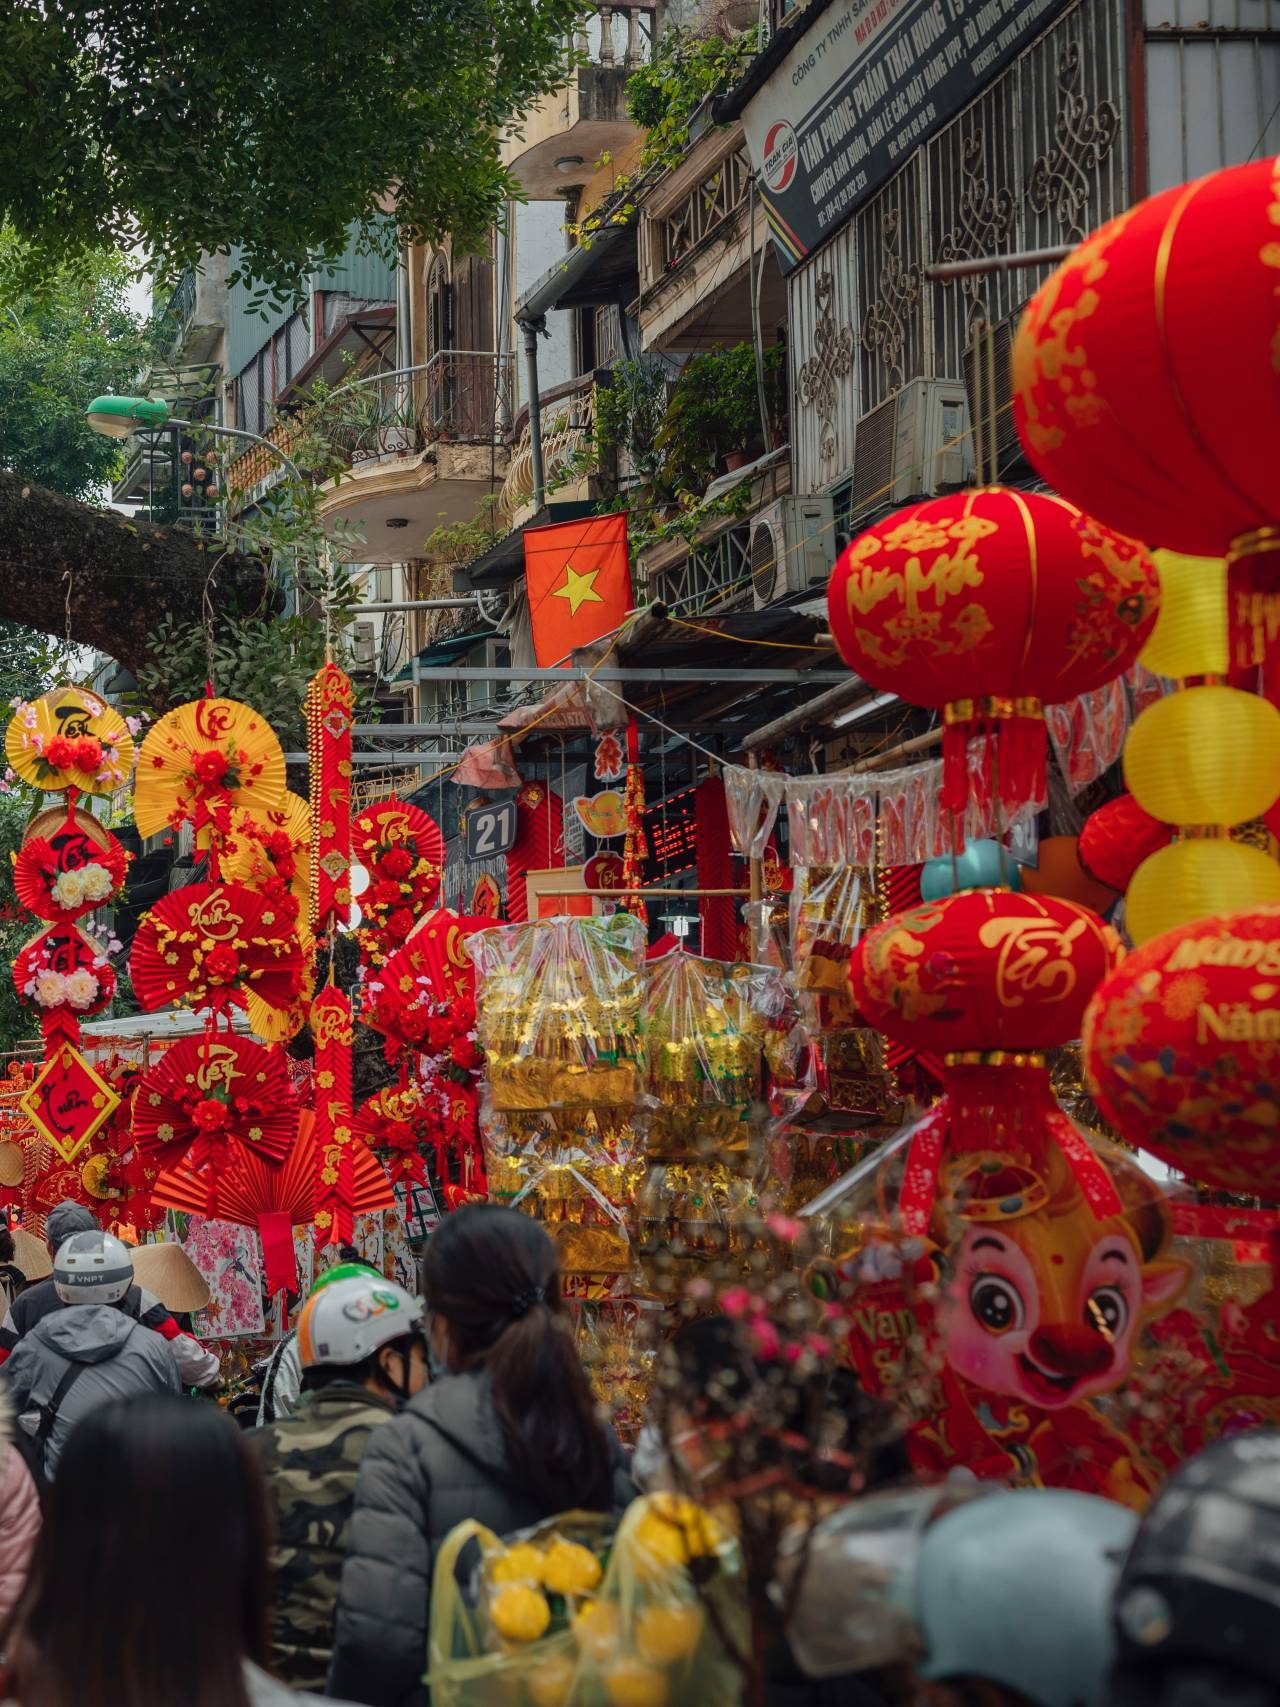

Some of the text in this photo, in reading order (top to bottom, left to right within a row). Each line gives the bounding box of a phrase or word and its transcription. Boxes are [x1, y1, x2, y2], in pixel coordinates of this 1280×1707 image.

[792, 54, 816, 86] CÔNG
[815, 41, 827, 58] TY
[827, 12, 853, 45] TNHH
[971, 41, 1000, 77] WEBSITE:
[800, 129, 825, 173] VĂN
[820, 96, 857, 152] PHÒNG
[852, 61, 889, 119] PHẨM
[884, 31, 915, 84] THÁI
[910, 0, 947, 58] HƯNG
[809, 163, 836, 205] CHUYÊN
[833, 151, 850, 181] BÁN
[866, 115, 885, 148] BÁN
[891, 92, 909, 123] CÁC
[905, 73, 926, 108] MẶT
[922, 52, 948, 90] HÀNG
[476, 809, 509, 854] 21
[77, 1275, 104, 1283] VNPT
